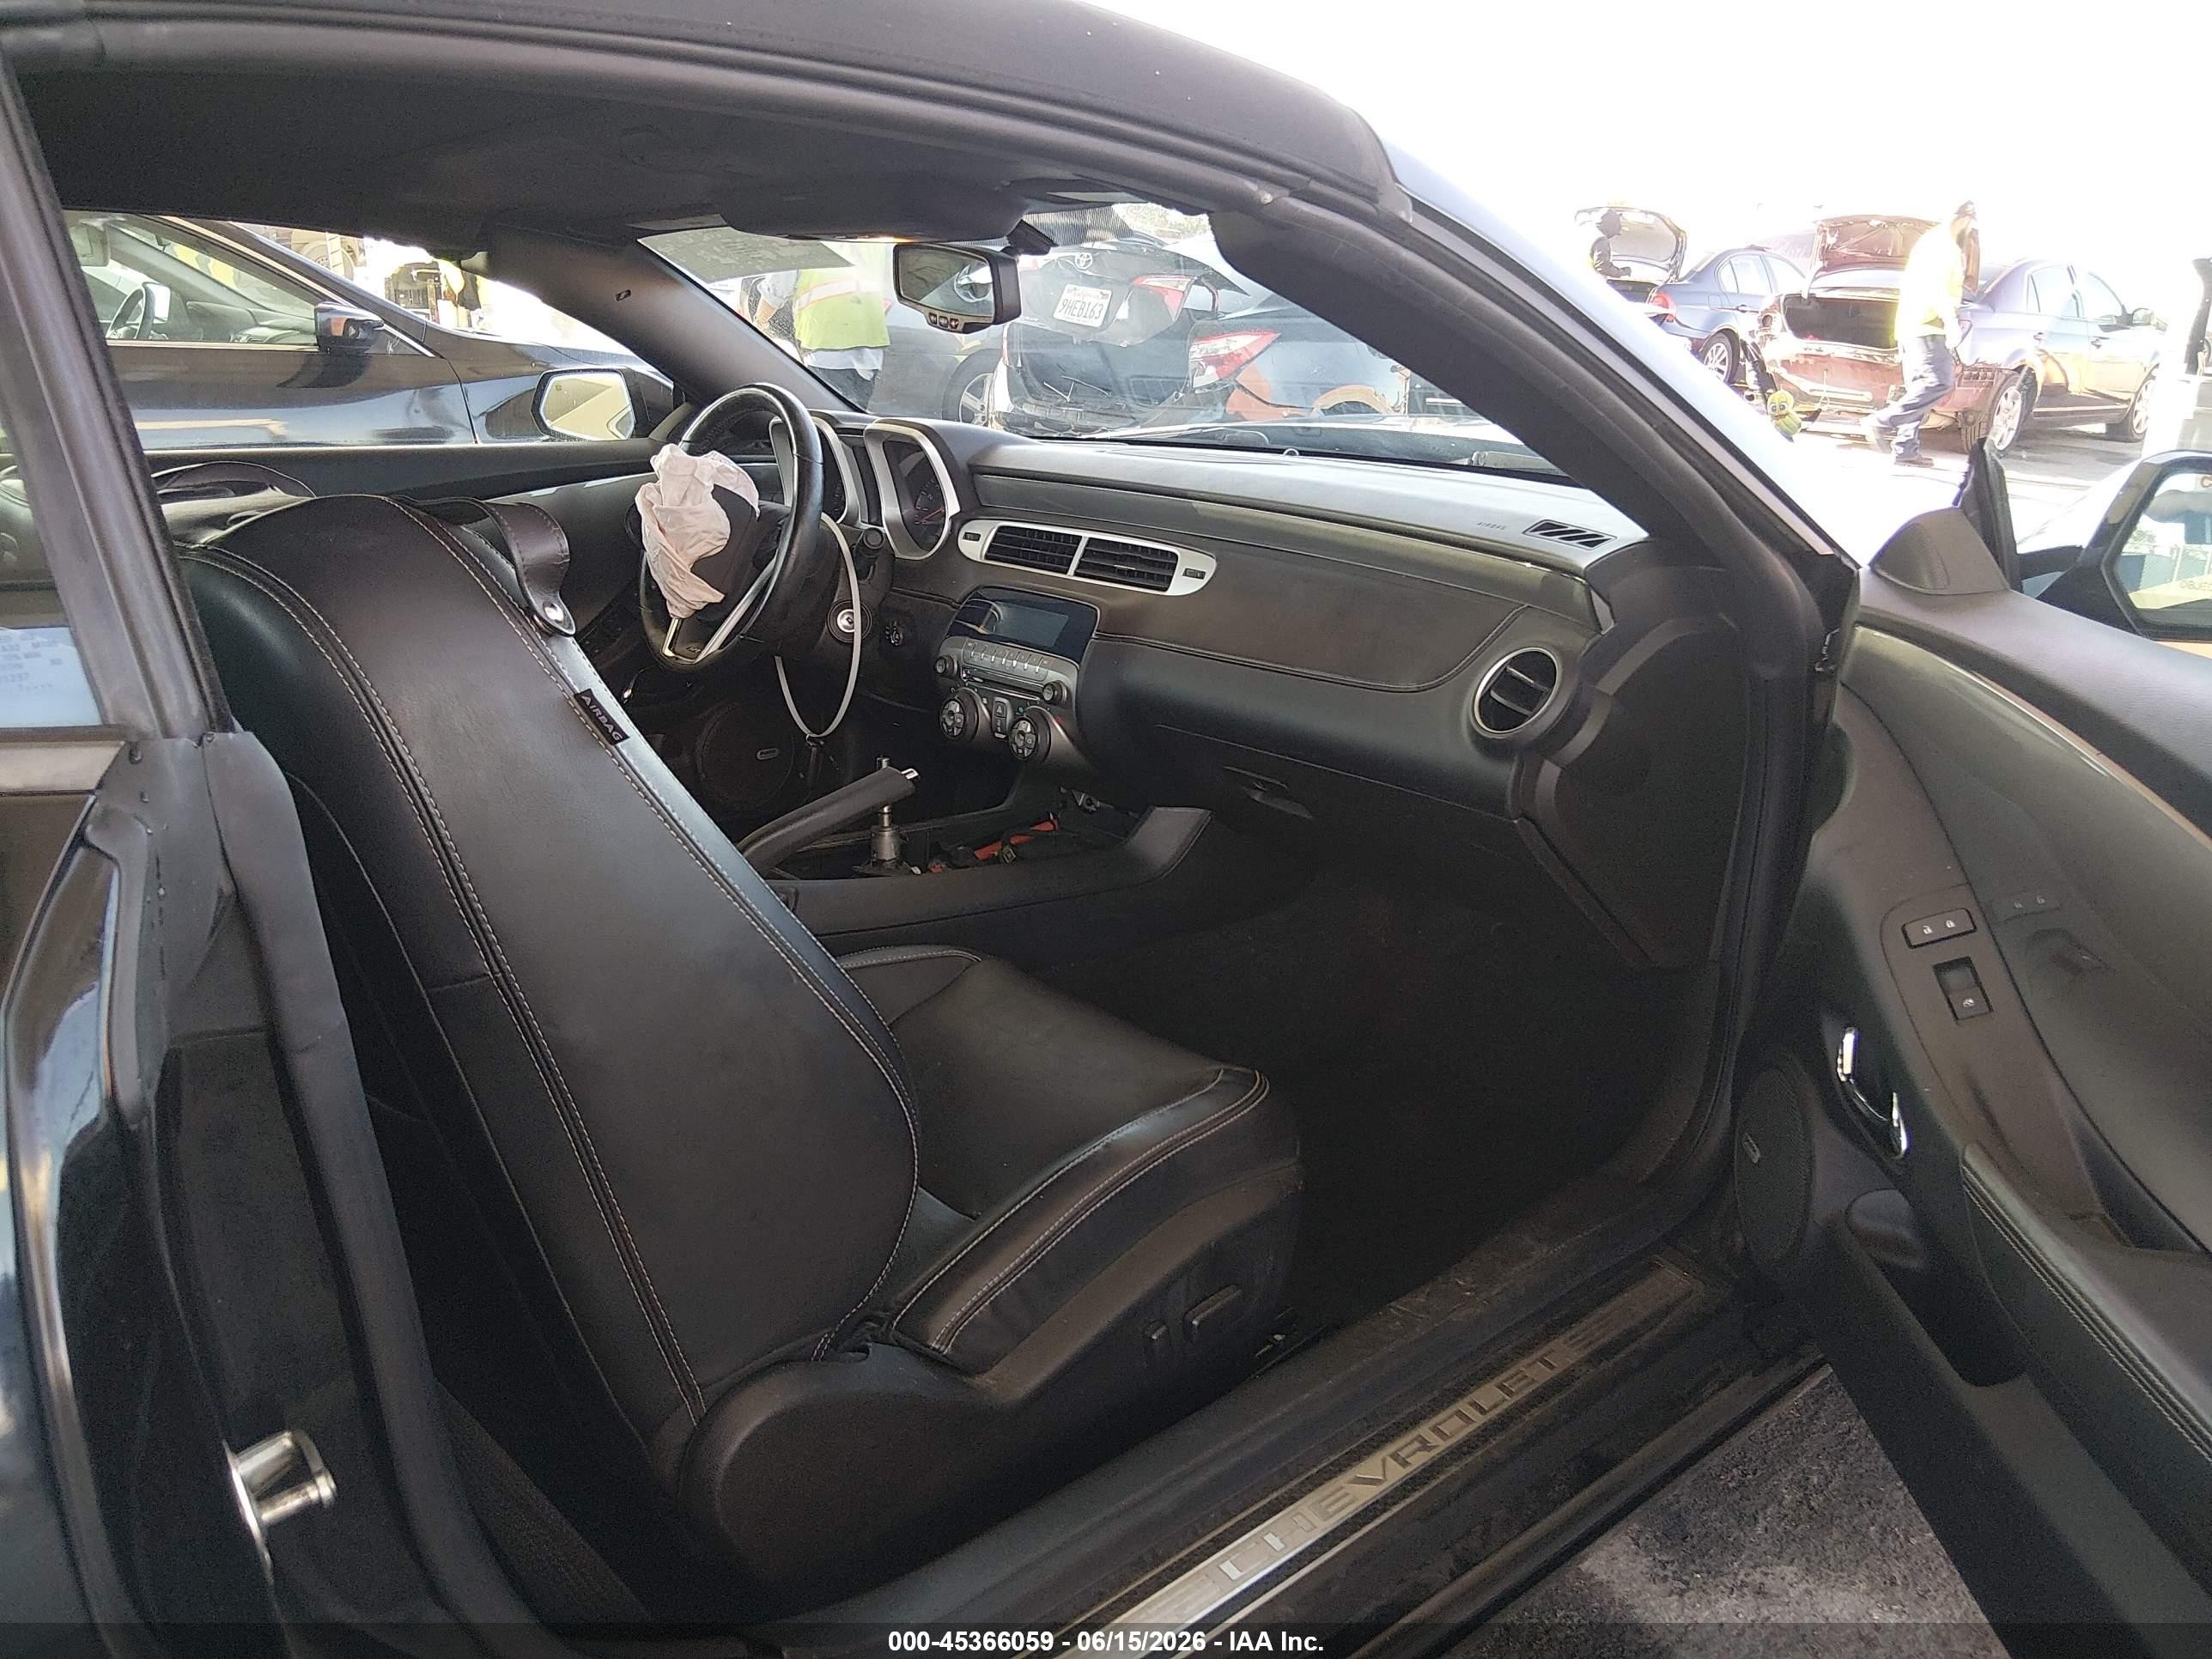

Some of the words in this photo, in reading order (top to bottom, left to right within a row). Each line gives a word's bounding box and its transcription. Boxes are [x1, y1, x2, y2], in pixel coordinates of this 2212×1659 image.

[1058, 298, 1103, 320] 9HEB163
[581, 696, 623, 741] AIRBAG
[1218, 1348, 1562, 1581] CHEVROLET
